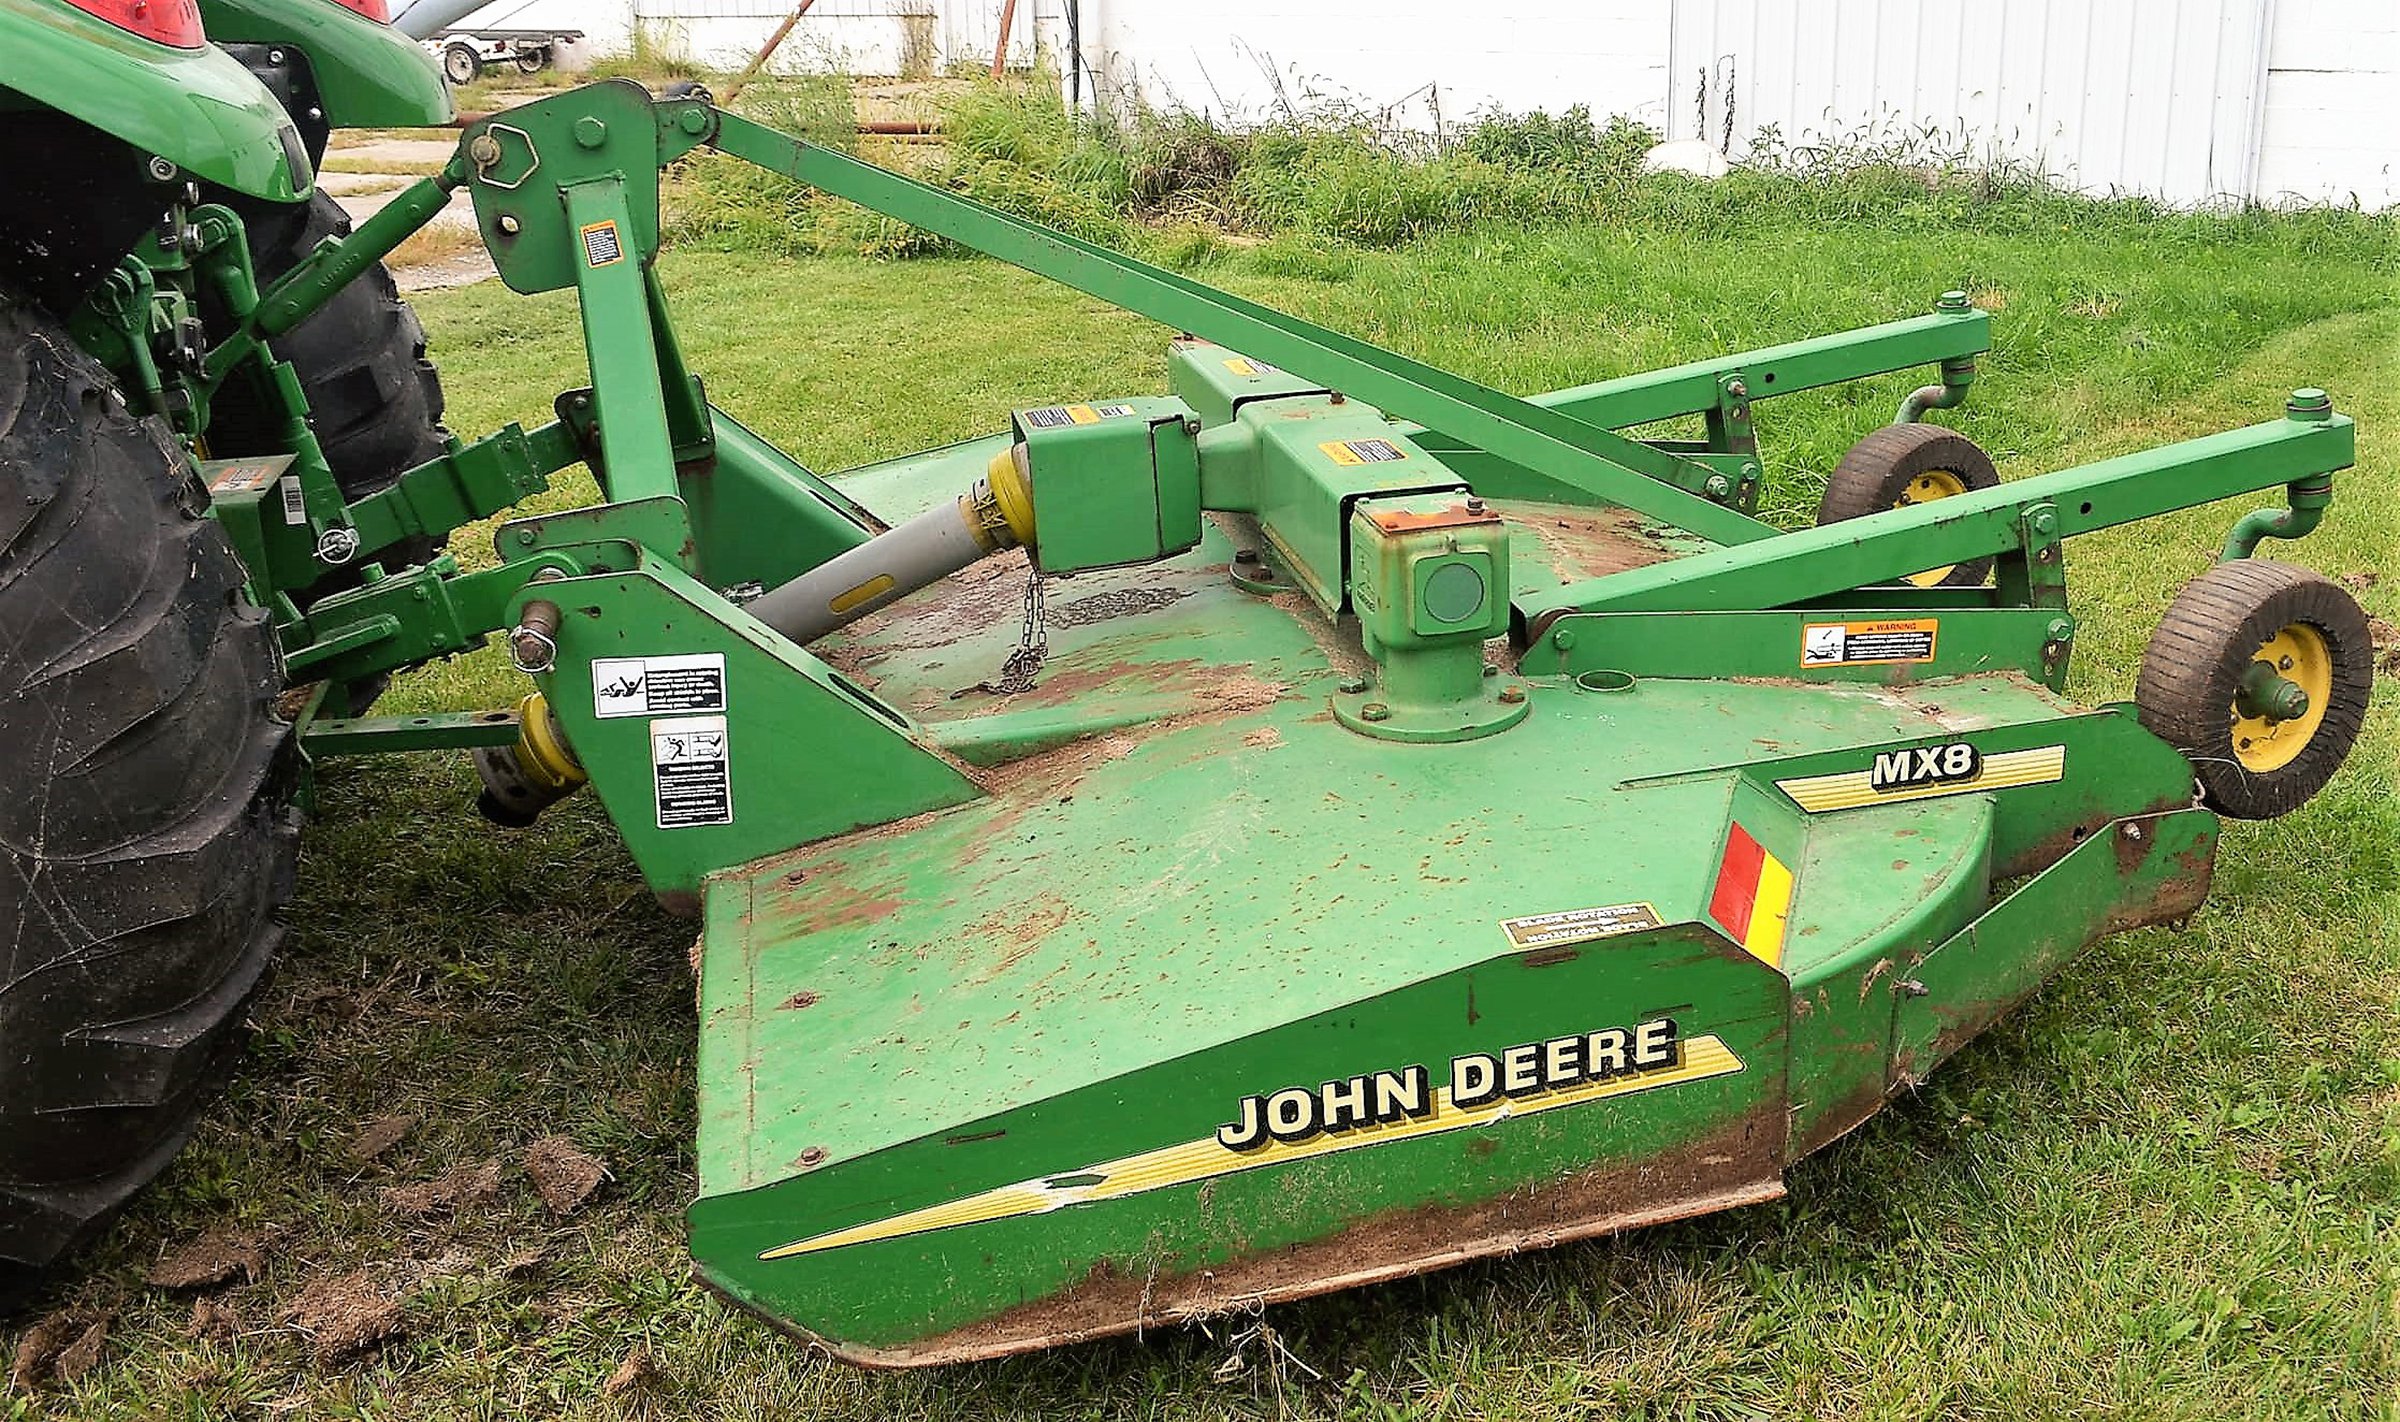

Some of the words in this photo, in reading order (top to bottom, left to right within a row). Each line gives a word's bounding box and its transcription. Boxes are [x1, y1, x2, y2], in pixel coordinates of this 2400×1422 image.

[1877, 622, 1917, 631] WARNING
[1872, 743, 1976, 788] MX8
[1218, 1066, 1427, 1149] JOHN
[1452, 1019, 1674, 1105] DEERE
